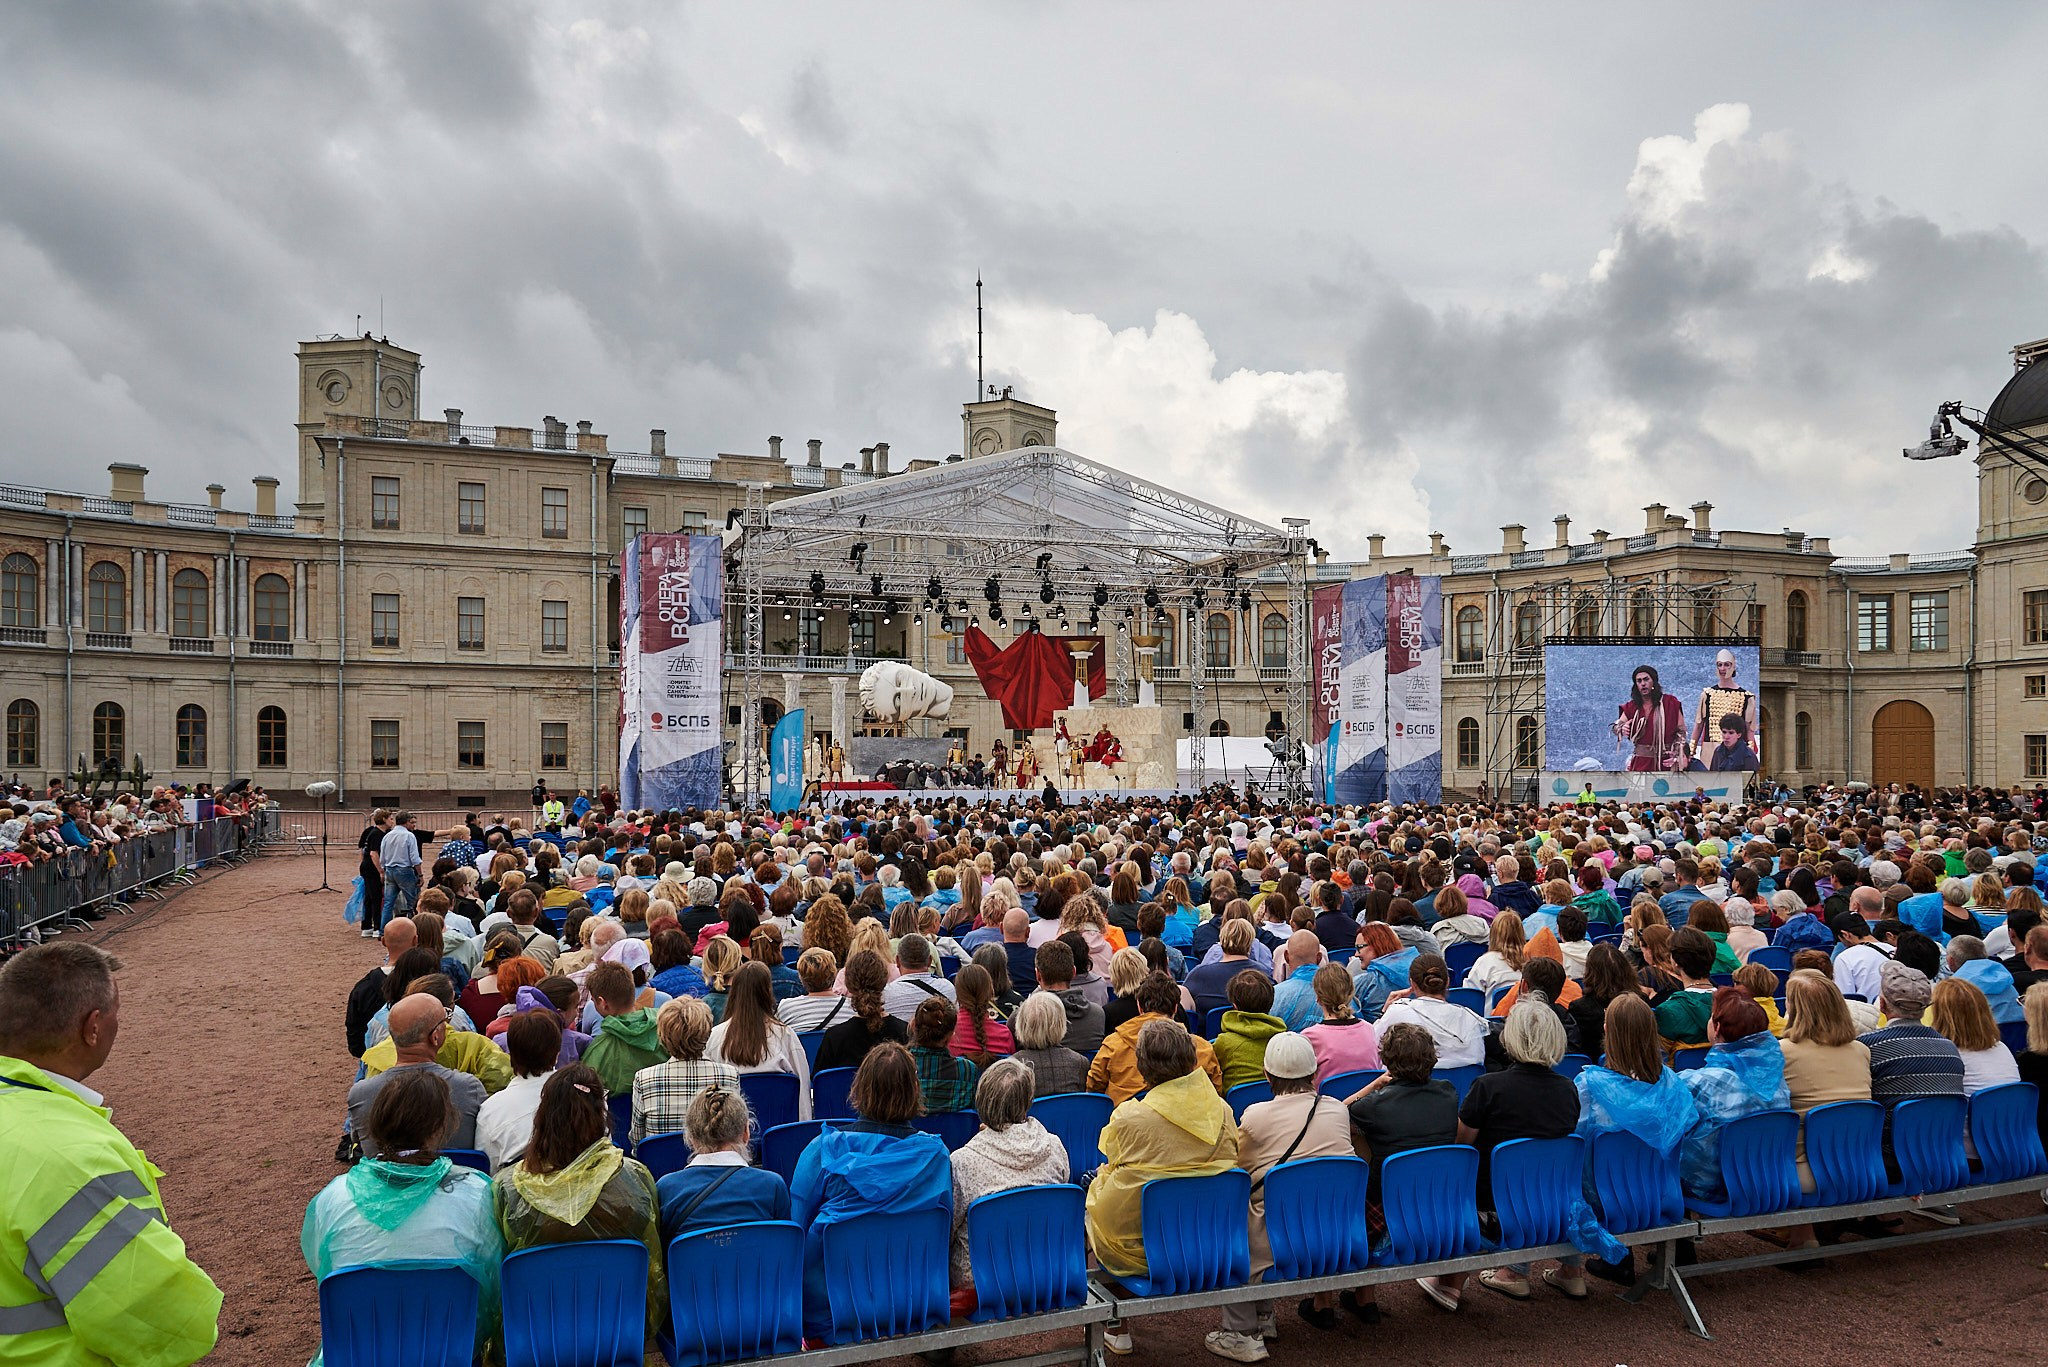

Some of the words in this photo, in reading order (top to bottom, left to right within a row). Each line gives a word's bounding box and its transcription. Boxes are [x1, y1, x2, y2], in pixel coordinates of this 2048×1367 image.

[658, 568, 672, 622] ОПЕРА-
[671, 571, 690, 639] ВСЕМ
[1400, 603, 1409, 648] ОПЕРА-
[1409, 606, 1422, 662] ВСЕМ
[1320, 640, 1330, 706] ОПЕРА-
[1328, 642, 1342, 724] ВСЕМ
[667, 715, 710, 727] БСПБ
[1352, 722, 1375, 732] БСПБ
[1406, 724, 1435, 734] БСПБ
